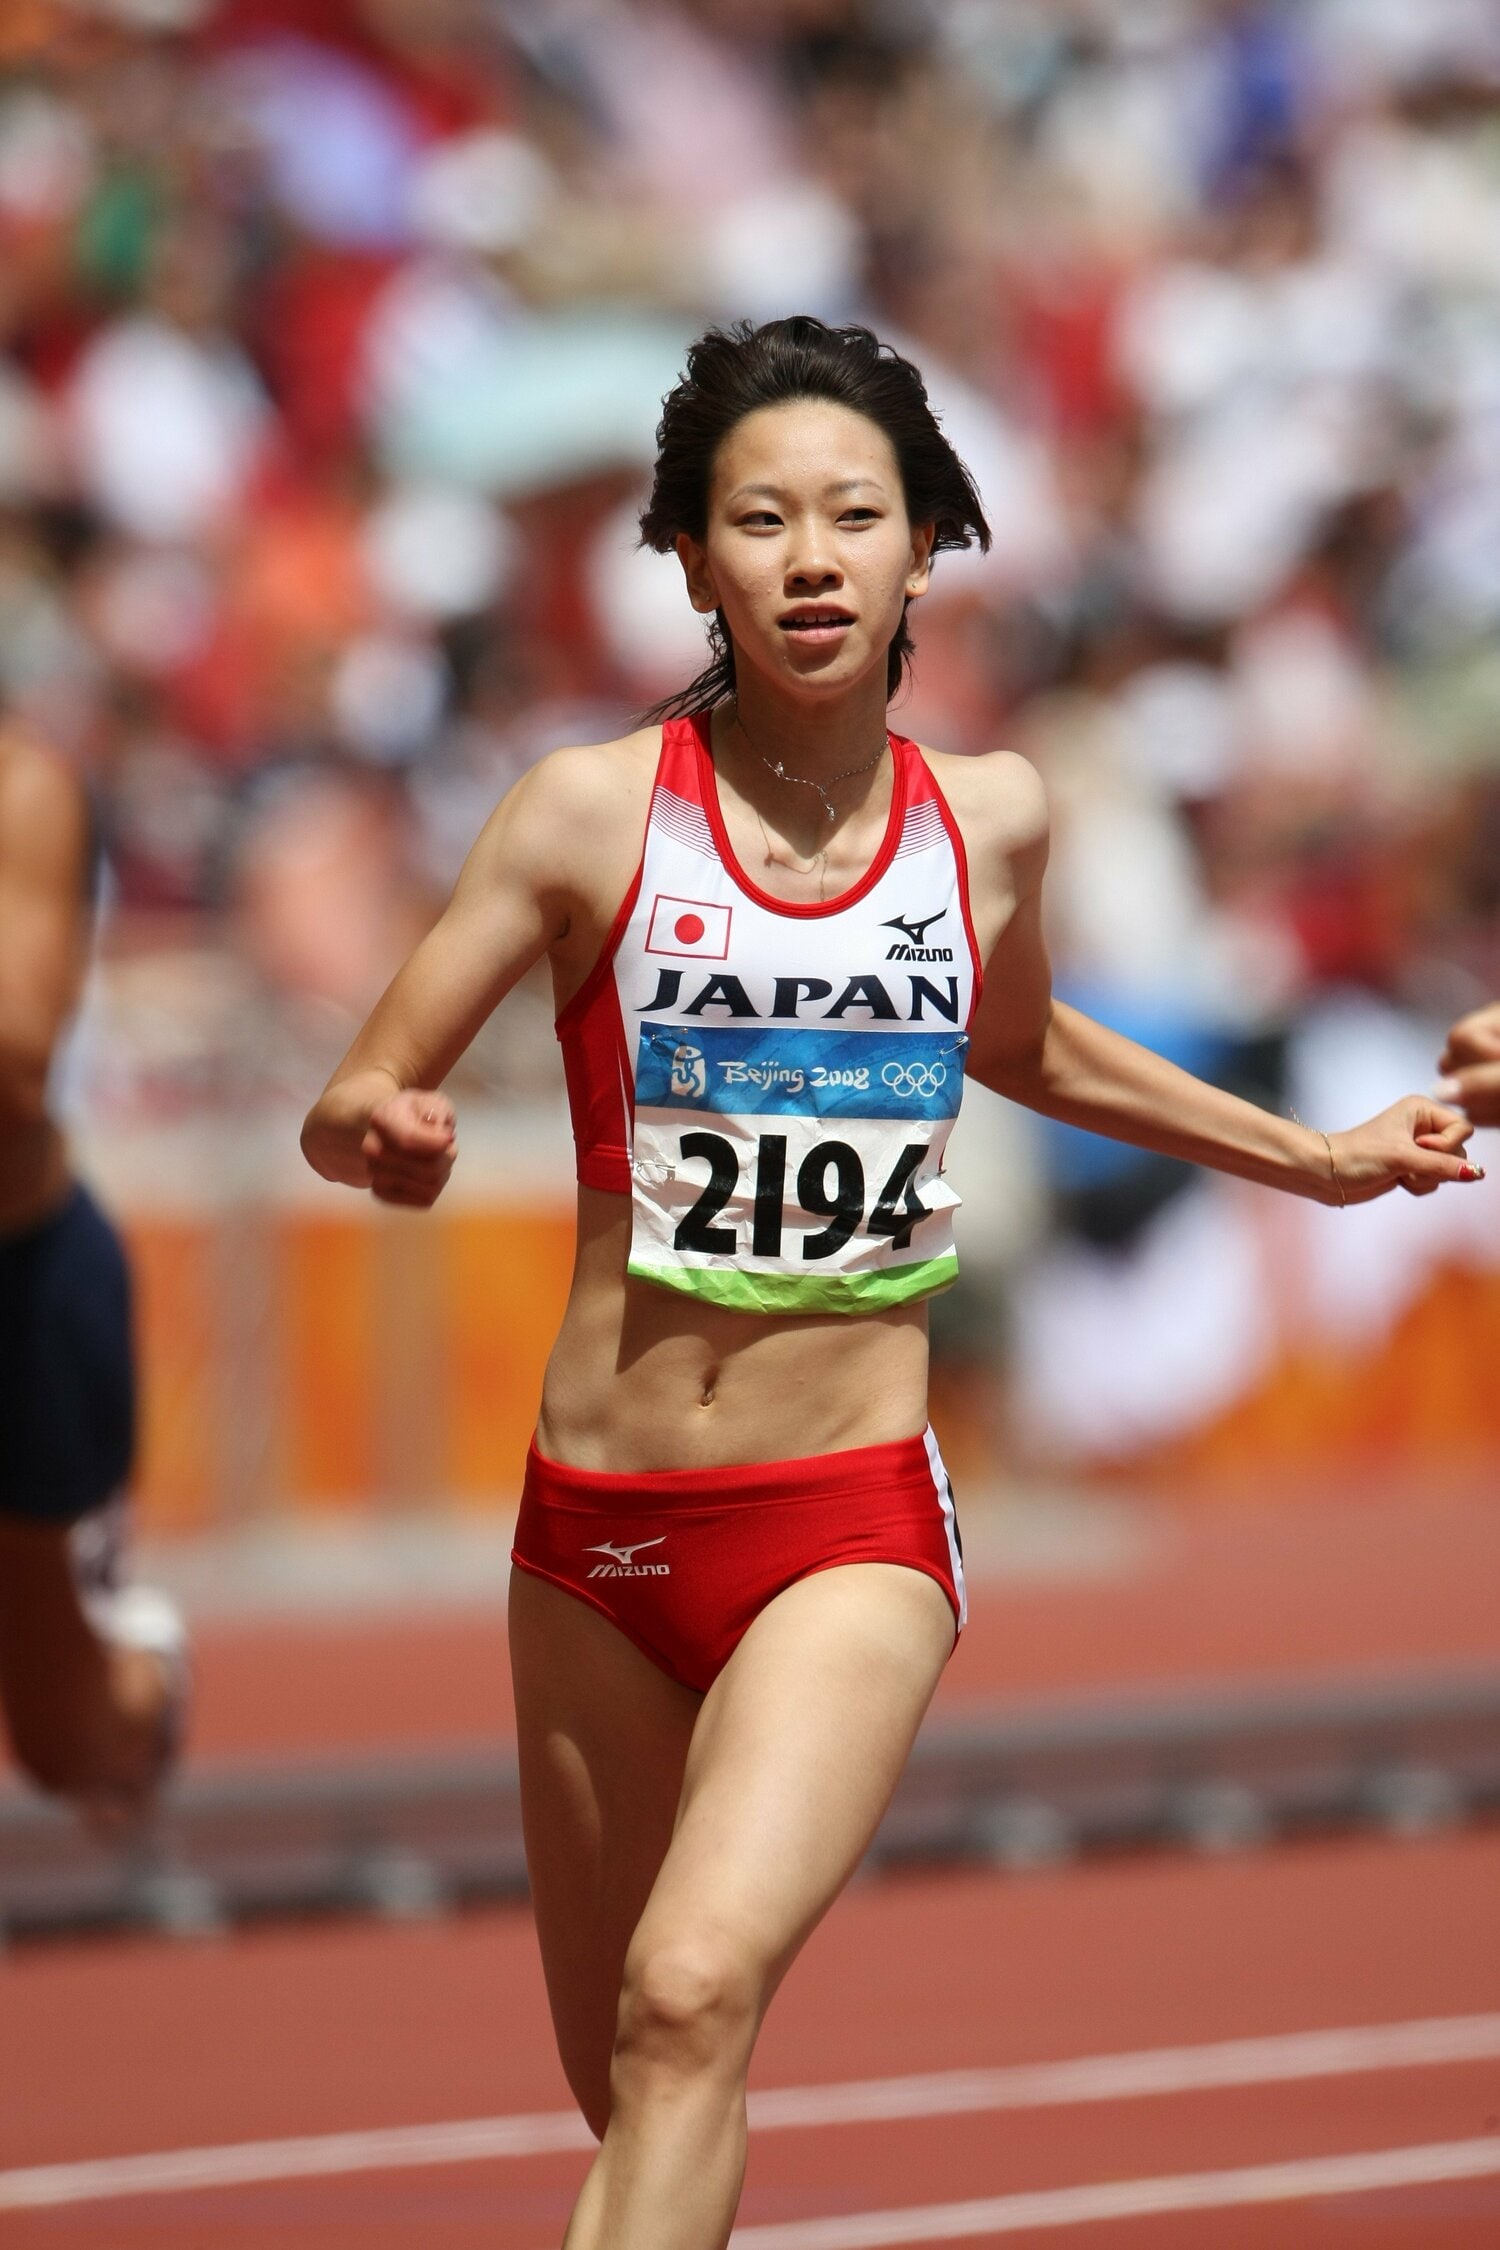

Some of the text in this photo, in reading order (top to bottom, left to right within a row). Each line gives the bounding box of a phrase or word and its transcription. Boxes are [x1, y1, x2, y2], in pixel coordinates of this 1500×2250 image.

[885, 944, 954, 962] MIZUNO
[634, 968, 960, 1024] JAPAN
[716, 1060, 870, 1093] Beijing 2008
[673, 1132, 934, 1261] 2194
[586, 1563, 671, 1578] MIZUNO
